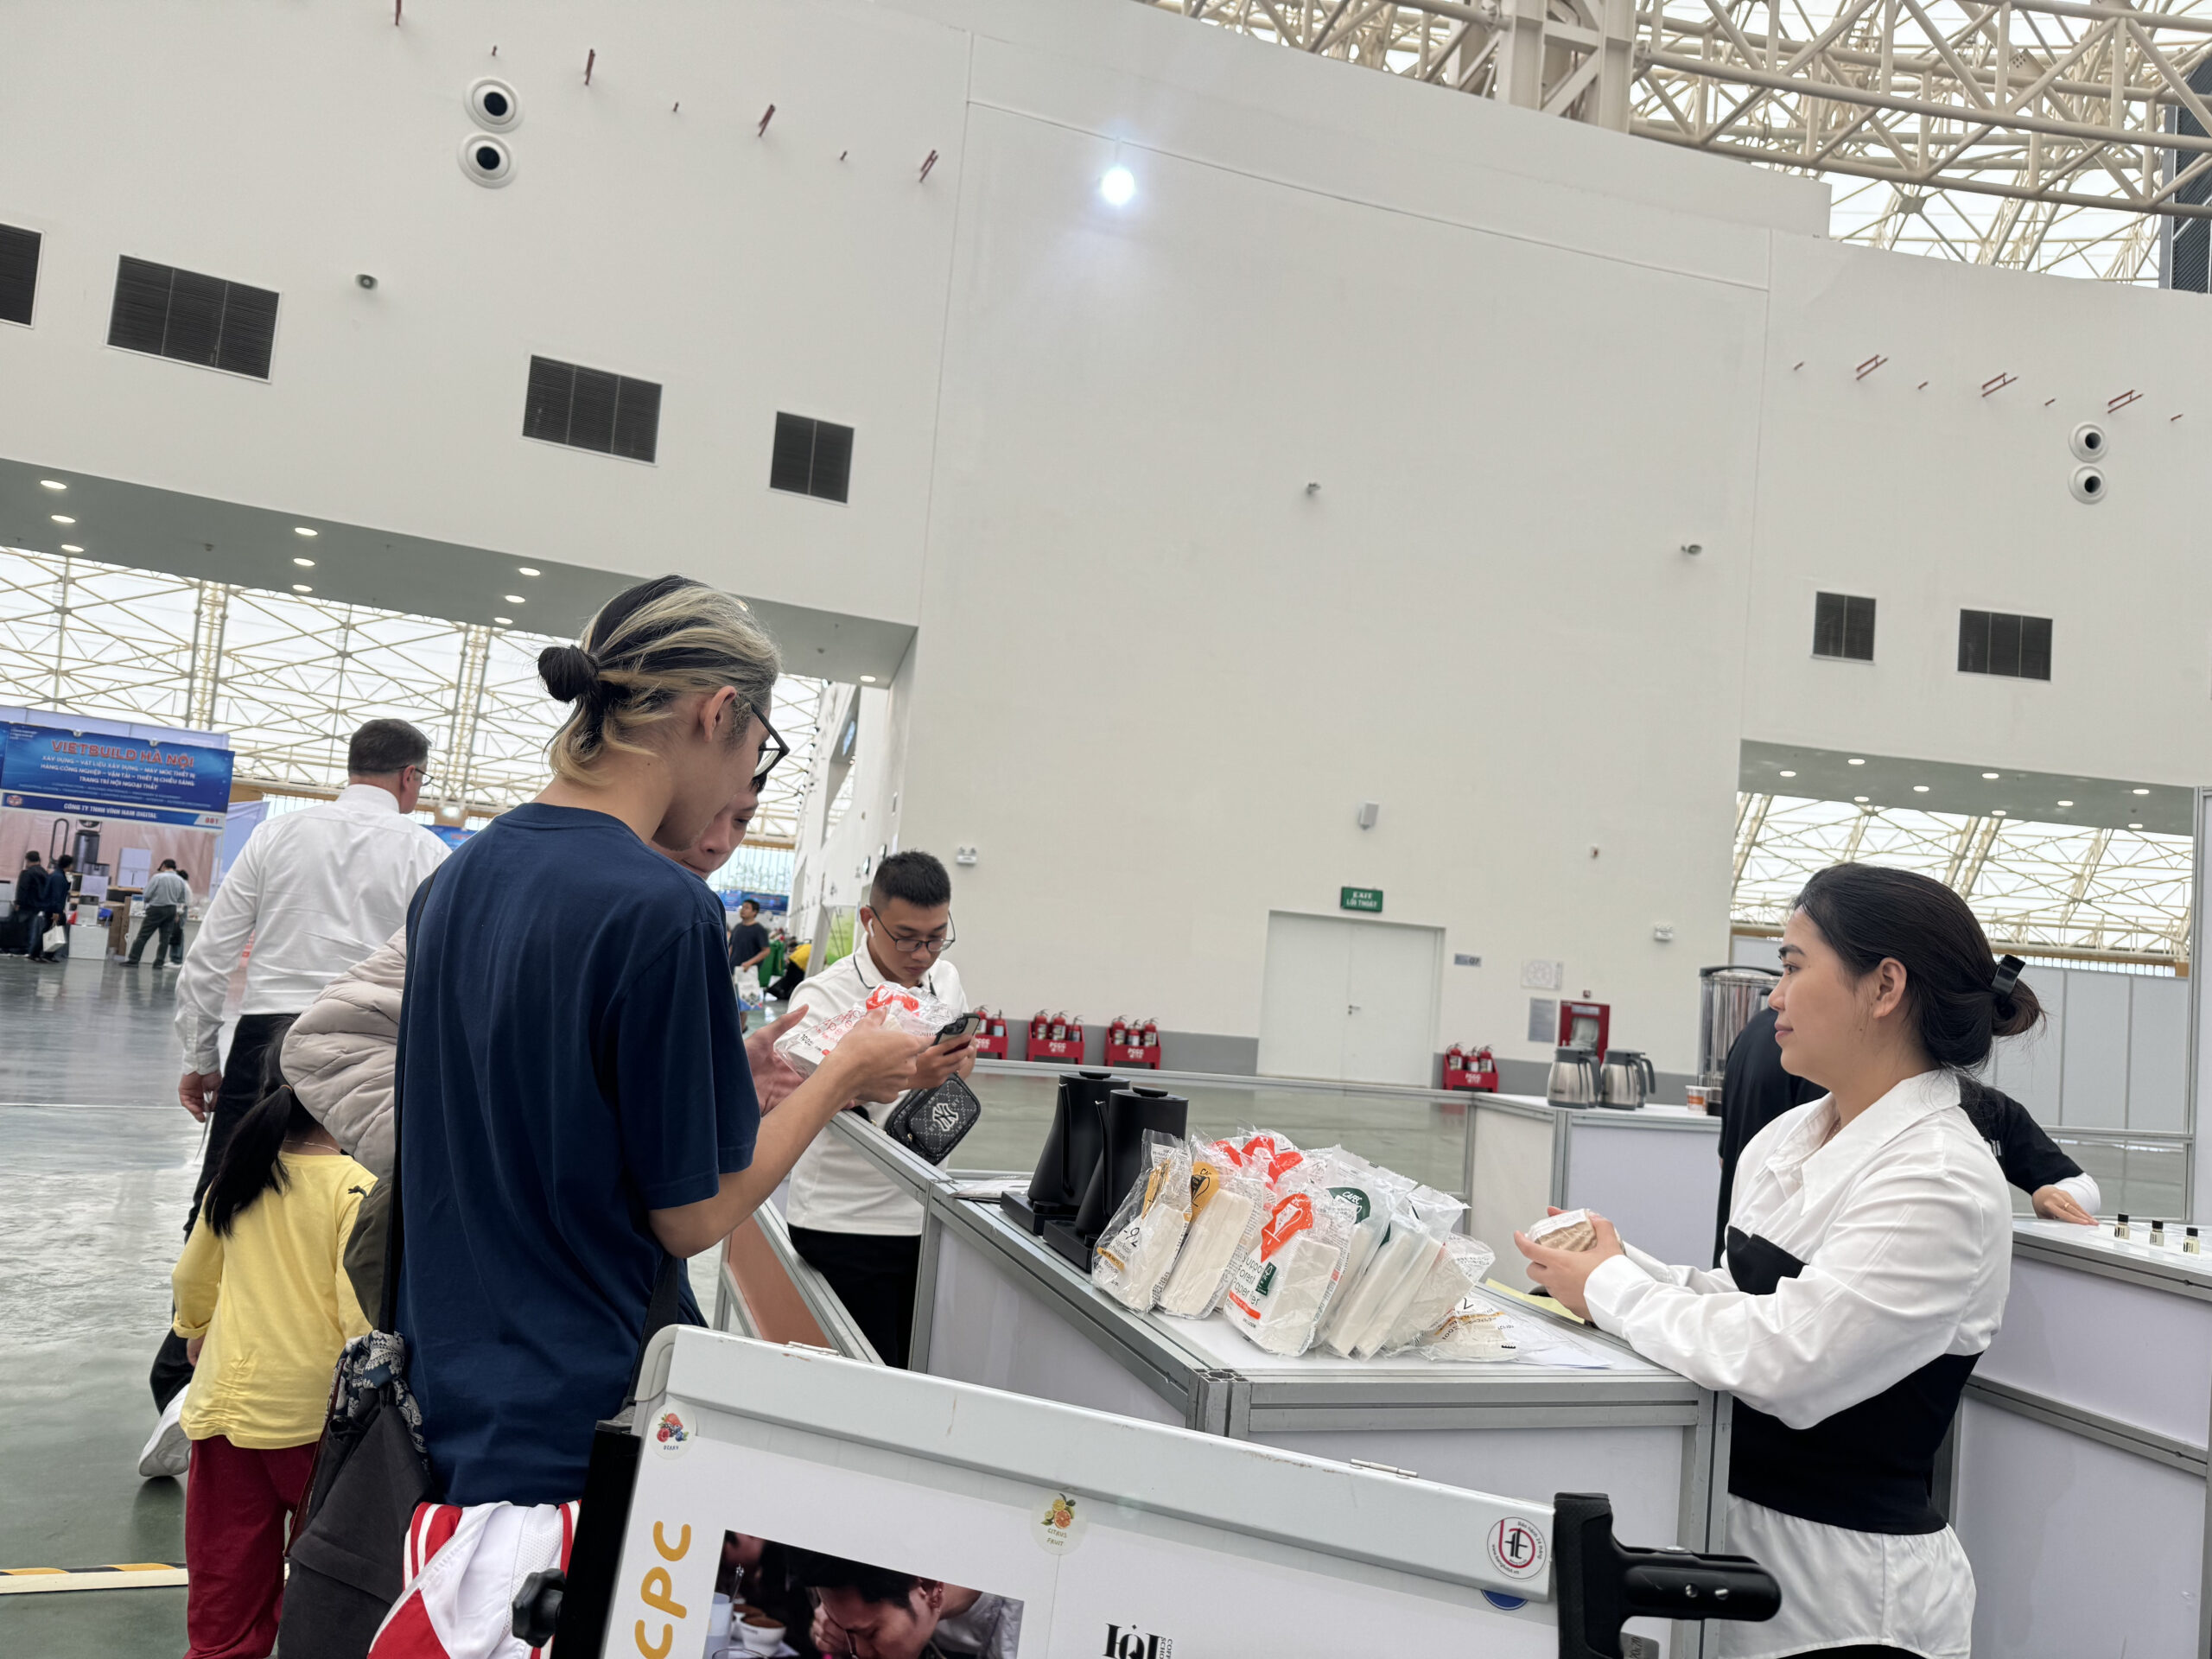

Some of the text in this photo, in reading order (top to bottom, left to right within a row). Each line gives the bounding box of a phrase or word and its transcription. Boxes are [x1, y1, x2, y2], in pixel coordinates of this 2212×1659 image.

[52, 740, 194, 770] VIETBUILD HÀ NỘI
[1047, 1528, 1067, 1539] CITRUS
[1046, 1537, 1065, 1546] FRUIT
